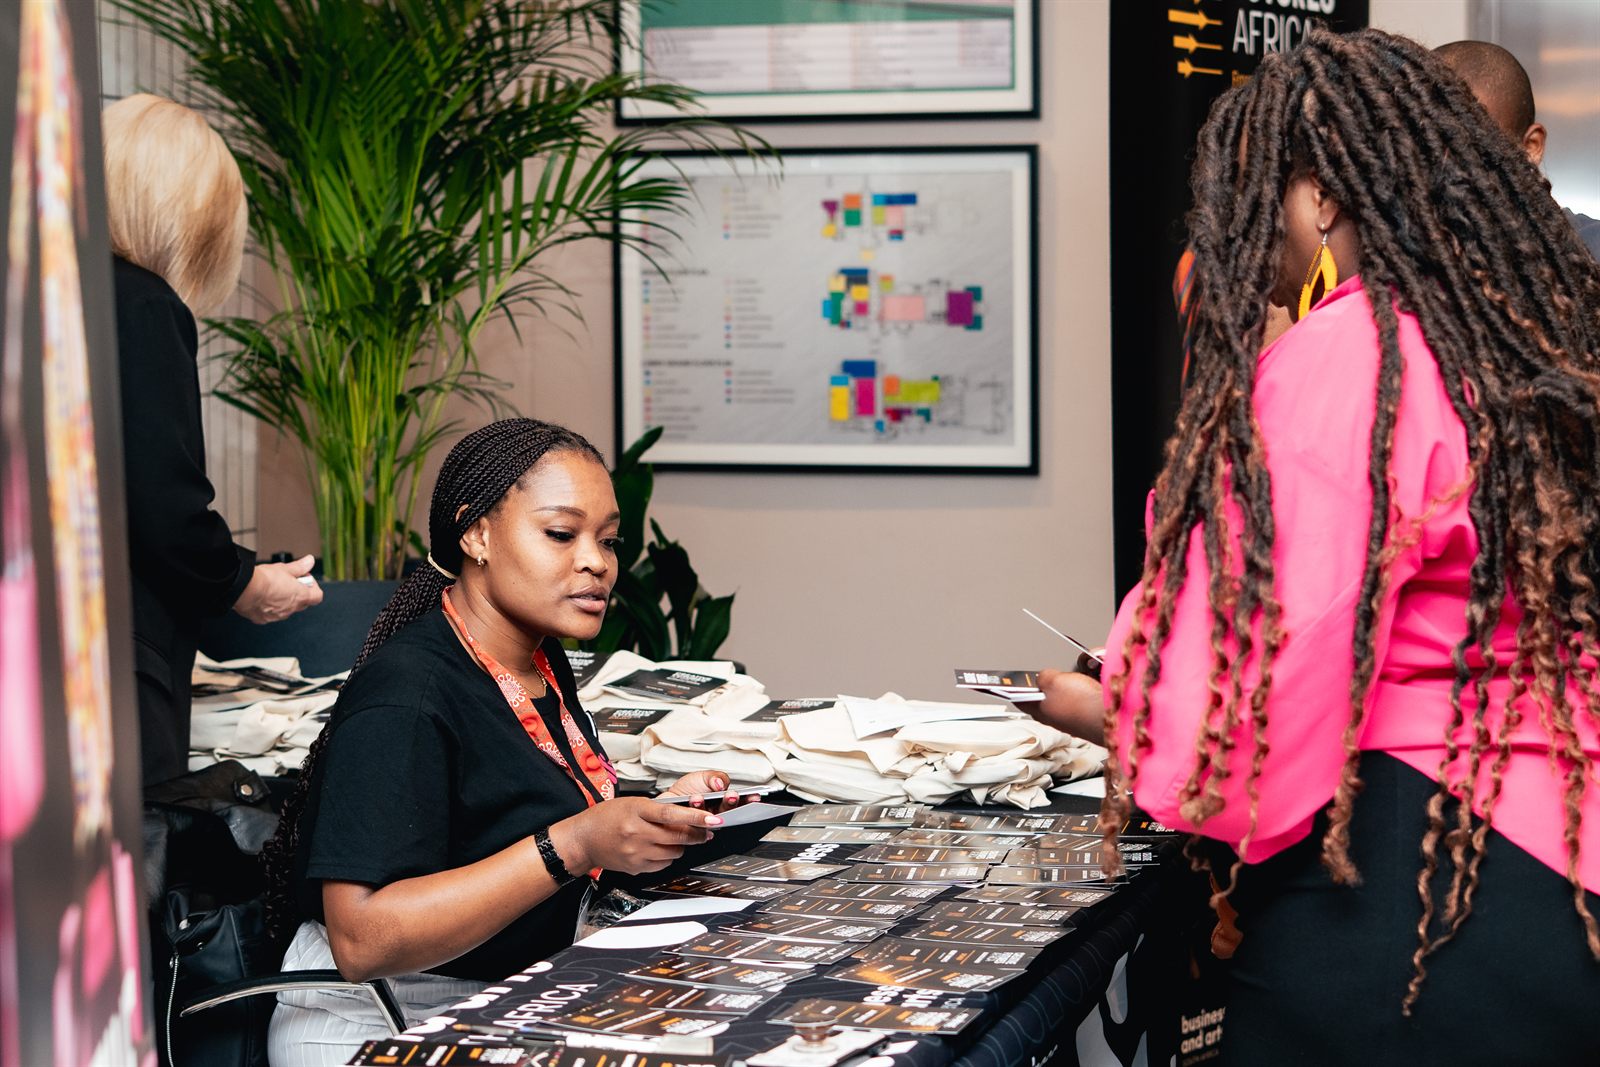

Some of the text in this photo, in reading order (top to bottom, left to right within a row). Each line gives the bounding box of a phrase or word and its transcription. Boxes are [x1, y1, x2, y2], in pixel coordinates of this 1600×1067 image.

[493, 983, 598, 1029] AFRICA
[1181, 1007, 1226, 1034] busines
[1181, 1029, 1204, 1054] and
